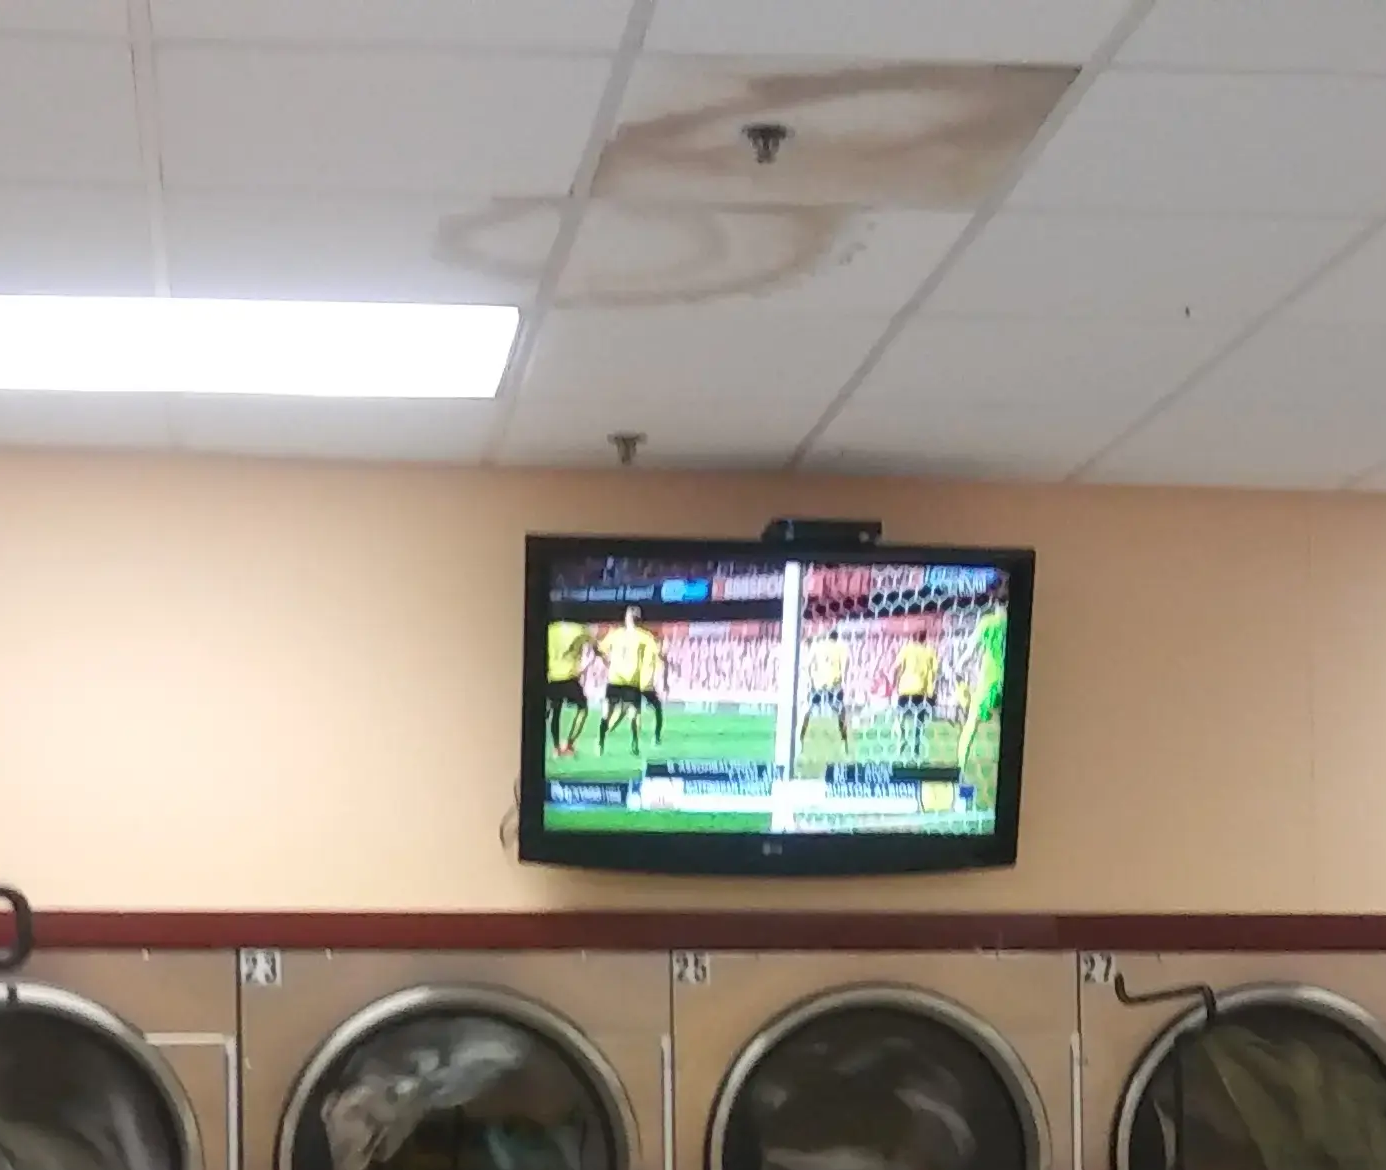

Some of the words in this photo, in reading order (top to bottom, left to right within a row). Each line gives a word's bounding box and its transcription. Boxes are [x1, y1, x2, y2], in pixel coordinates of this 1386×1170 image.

[243, 950, 279, 984] 23
[675, 950, 707, 982] 25
[1083, 950, 1114, 983] 27
